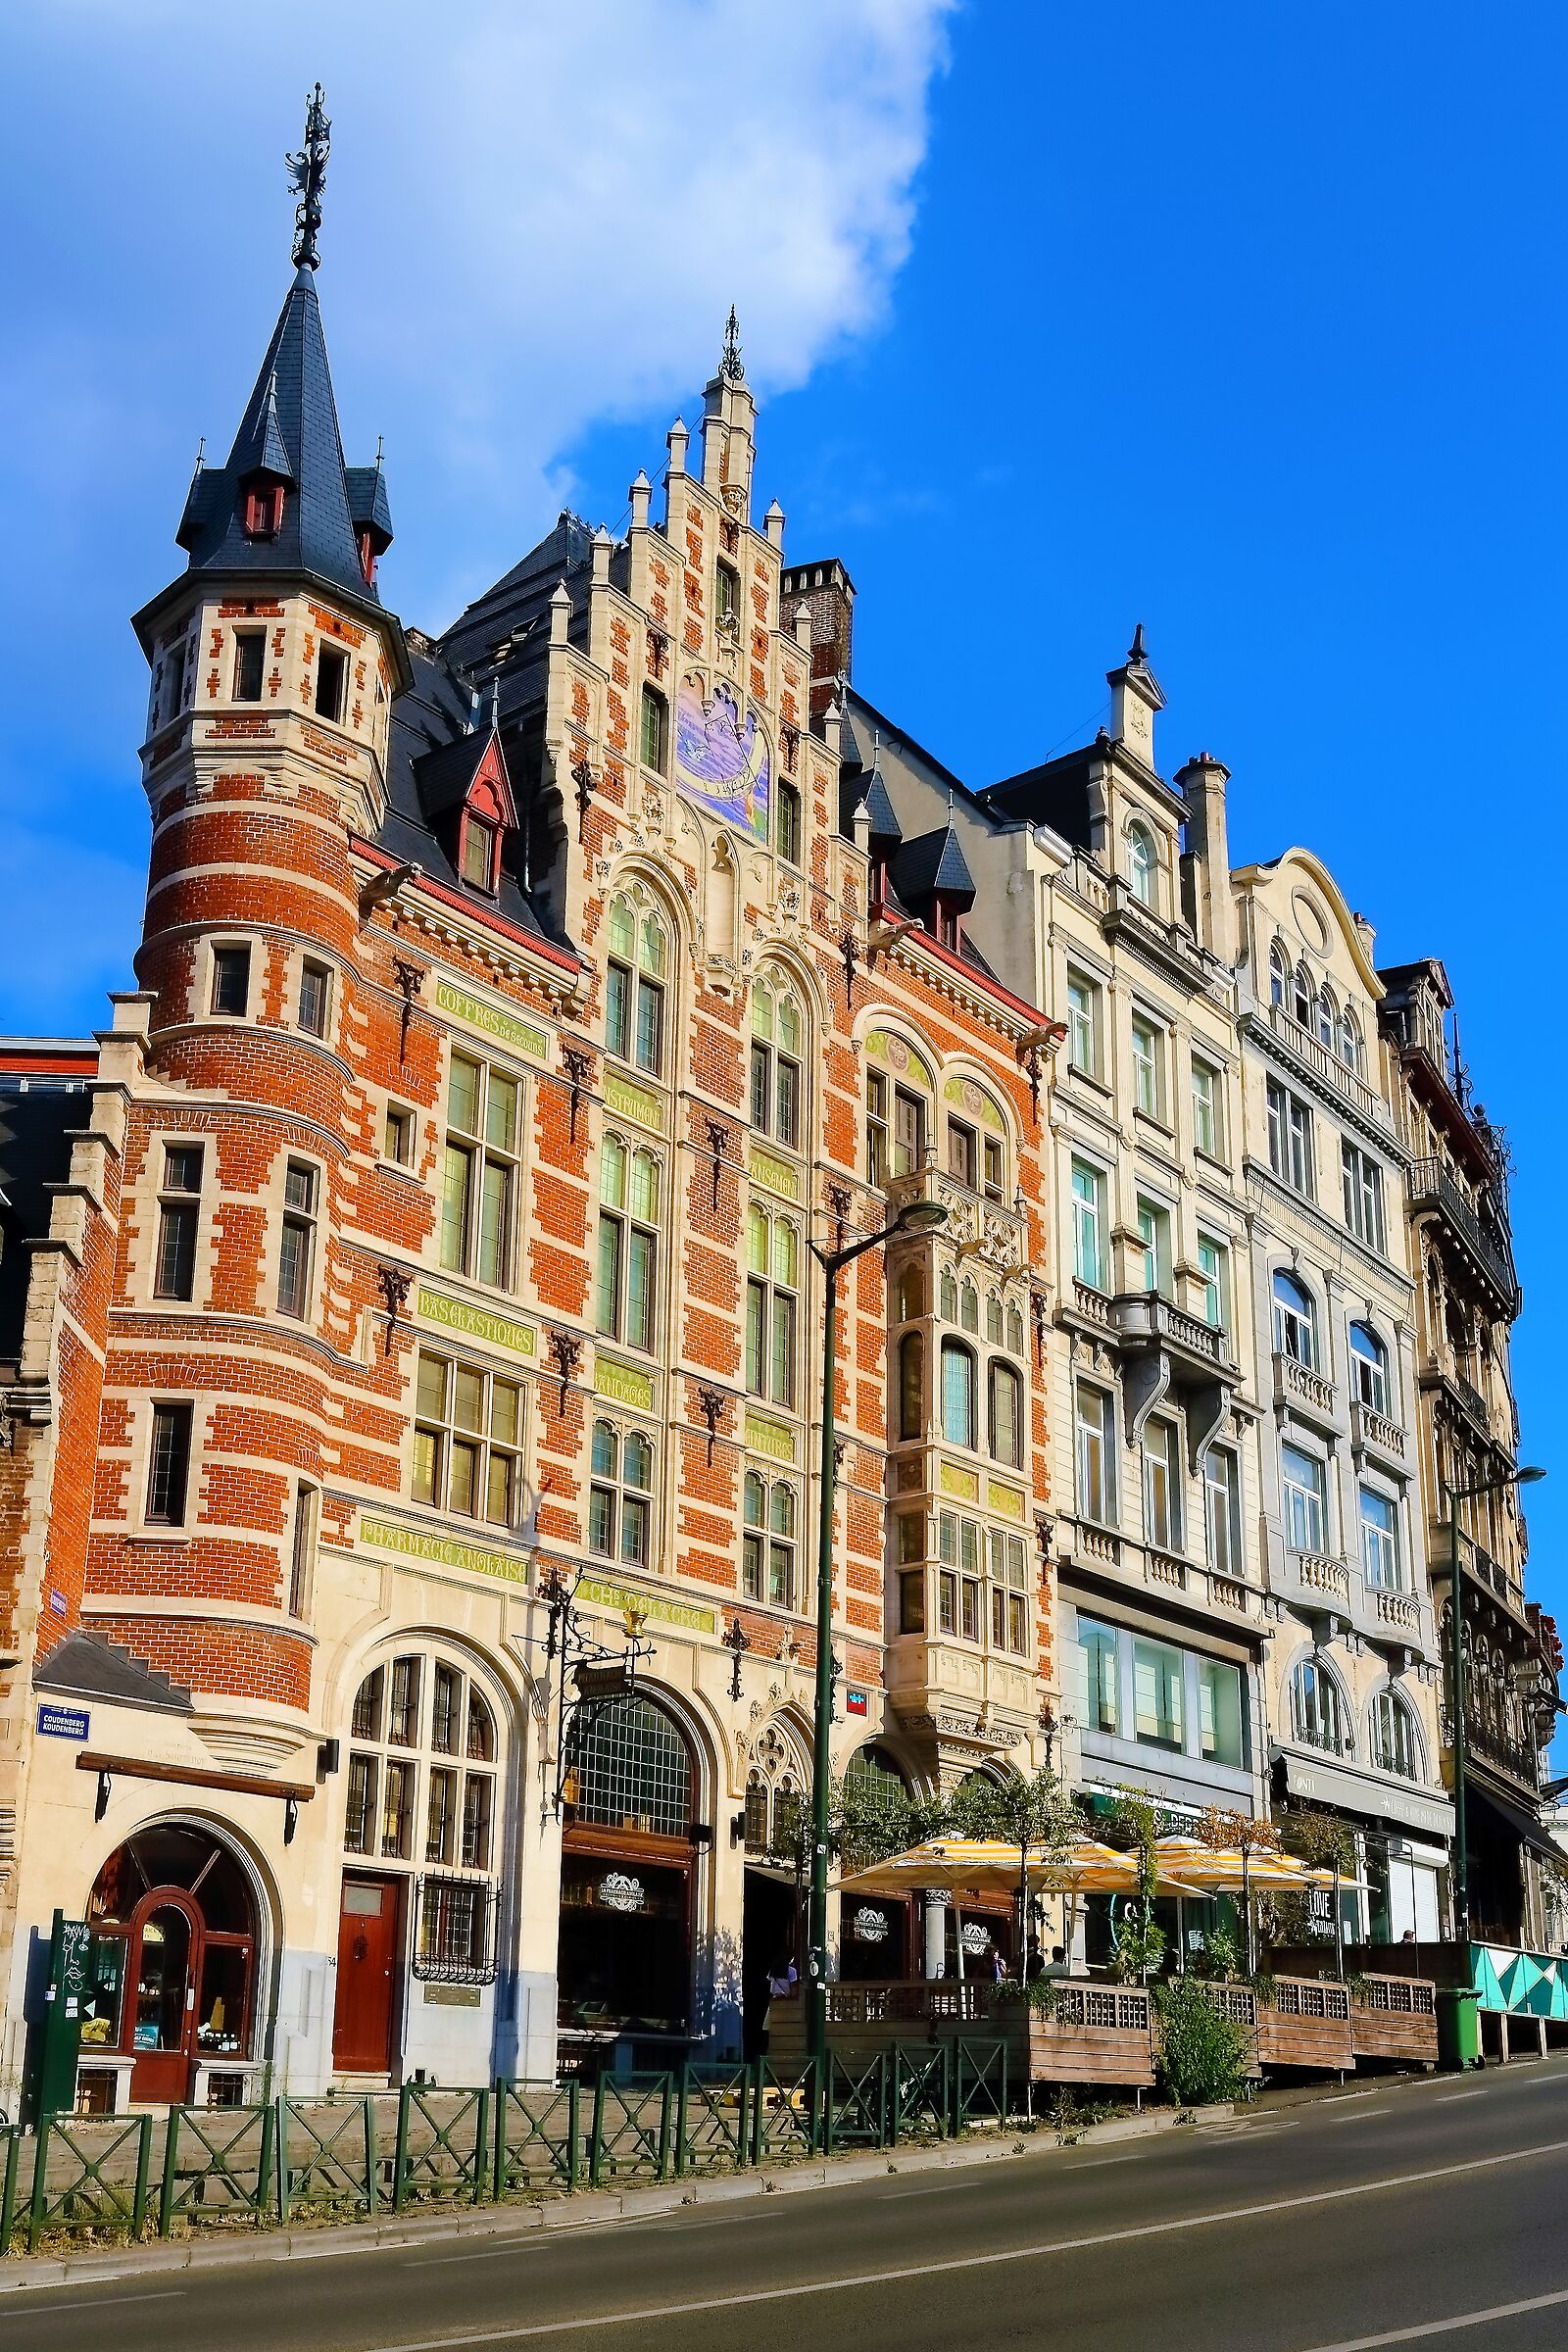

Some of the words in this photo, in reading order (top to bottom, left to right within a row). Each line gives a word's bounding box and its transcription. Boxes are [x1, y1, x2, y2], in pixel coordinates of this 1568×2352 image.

[419, 1292, 448, 1322] BAS
[363, 1521, 453, 1563] PHARMACIE
[456, 1545, 527, 1582] ANGLAISE
[42, 1724, 84, 1736] KOUDENBERG
[43, 1715, 85, 1728] COUDENBERG
[1309, 1888, 1331, 1918] LOVE
